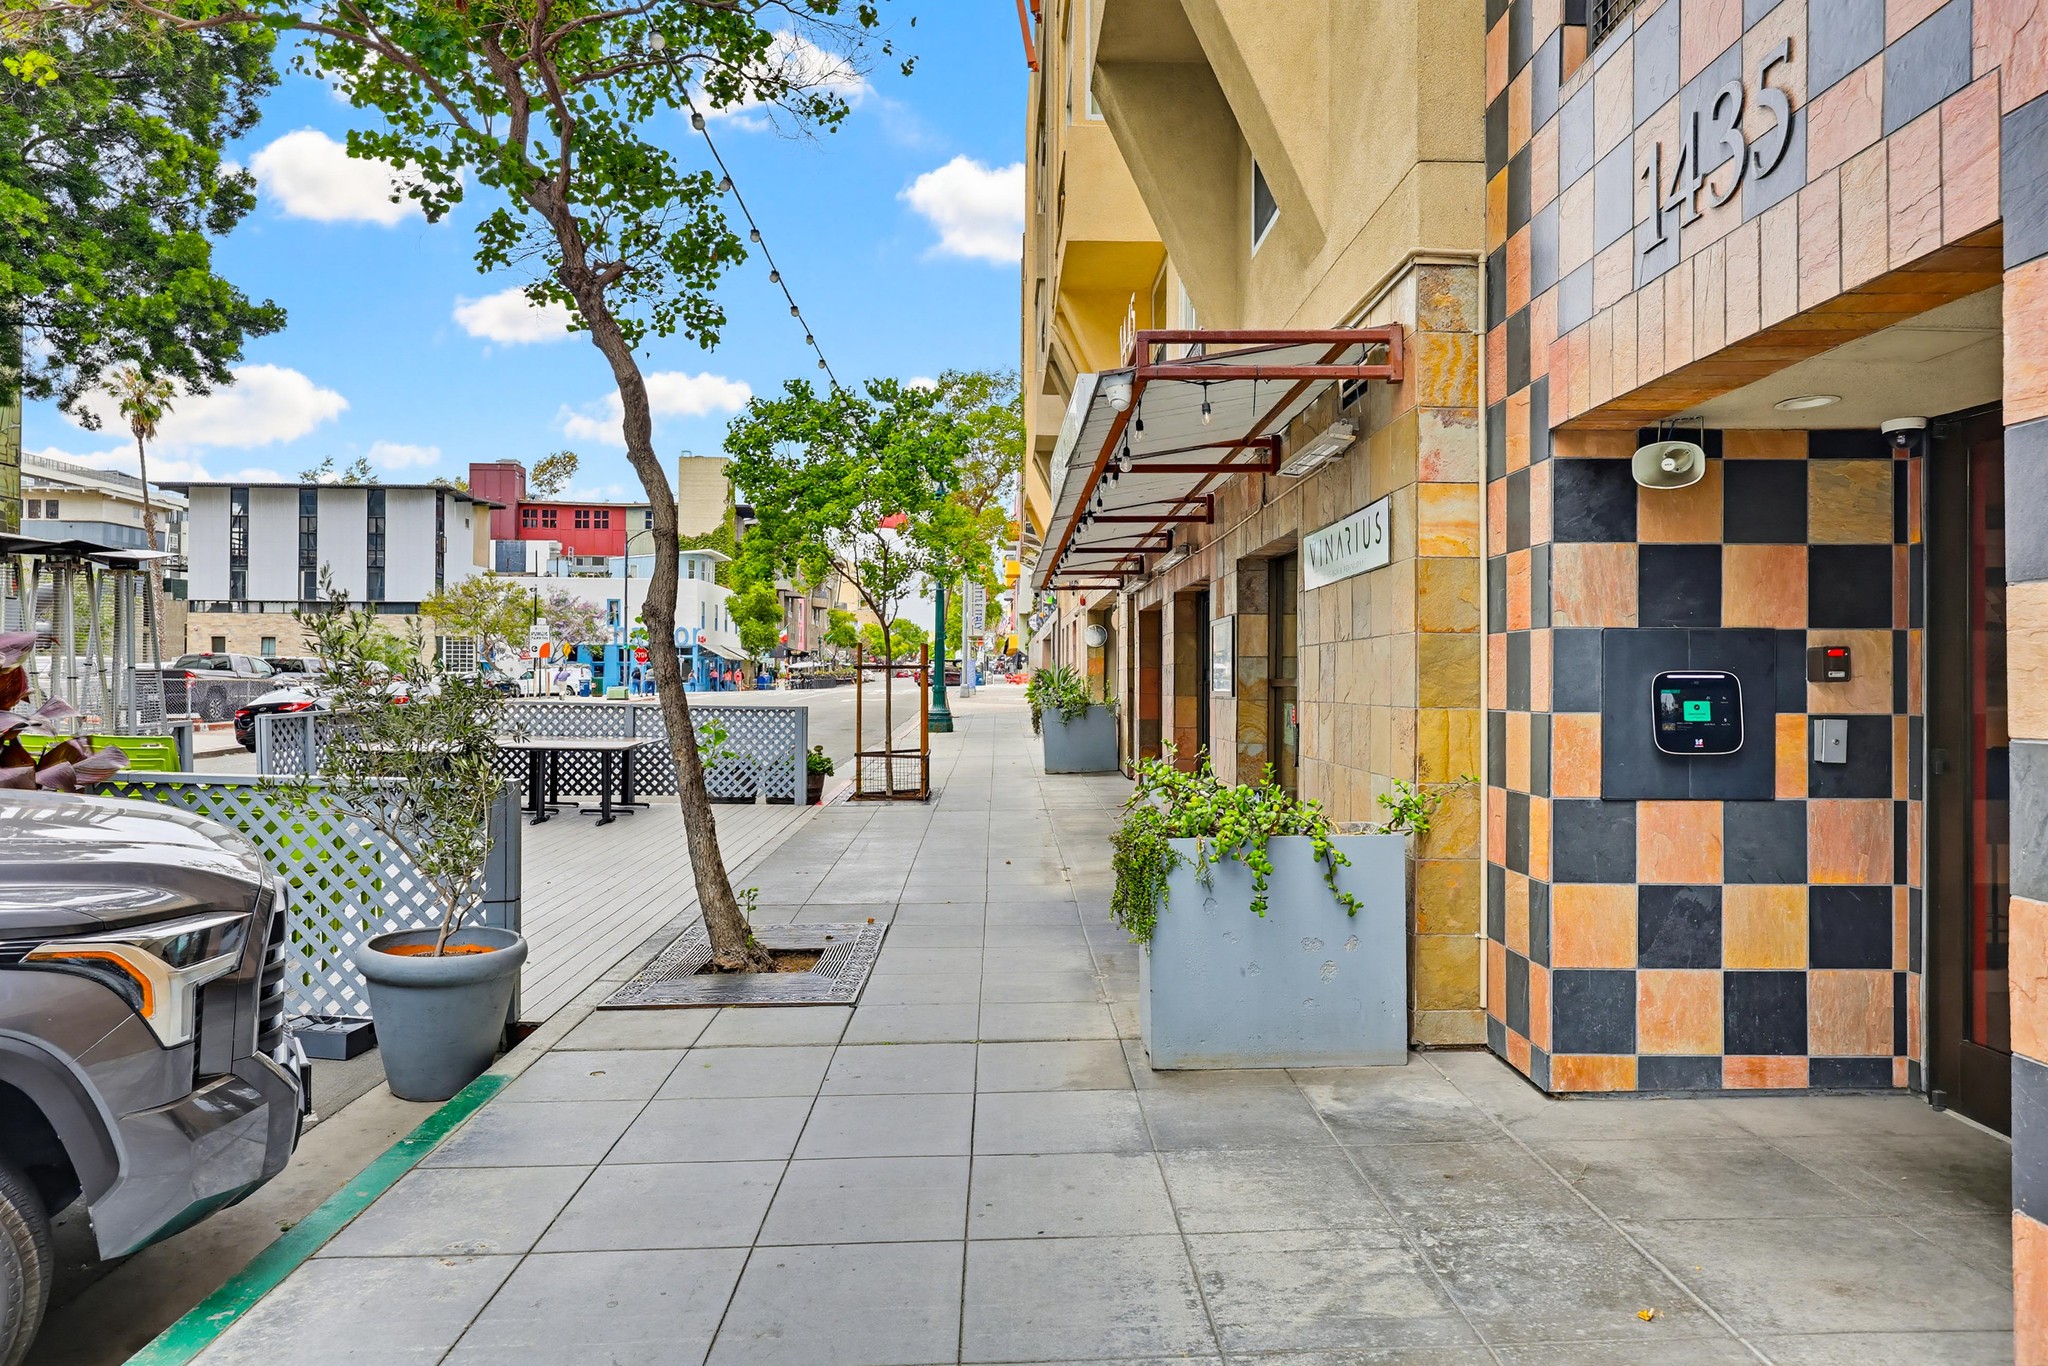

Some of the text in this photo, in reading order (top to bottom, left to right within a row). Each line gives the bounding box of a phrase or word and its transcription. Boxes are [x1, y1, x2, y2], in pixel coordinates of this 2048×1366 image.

[1641, 36, 1795, 254] 1435
[1309, 511, 1382, 570] VINARIUS
[974, 609, 983, 630] ITALY
[634, 651, 648, 659] STOP
